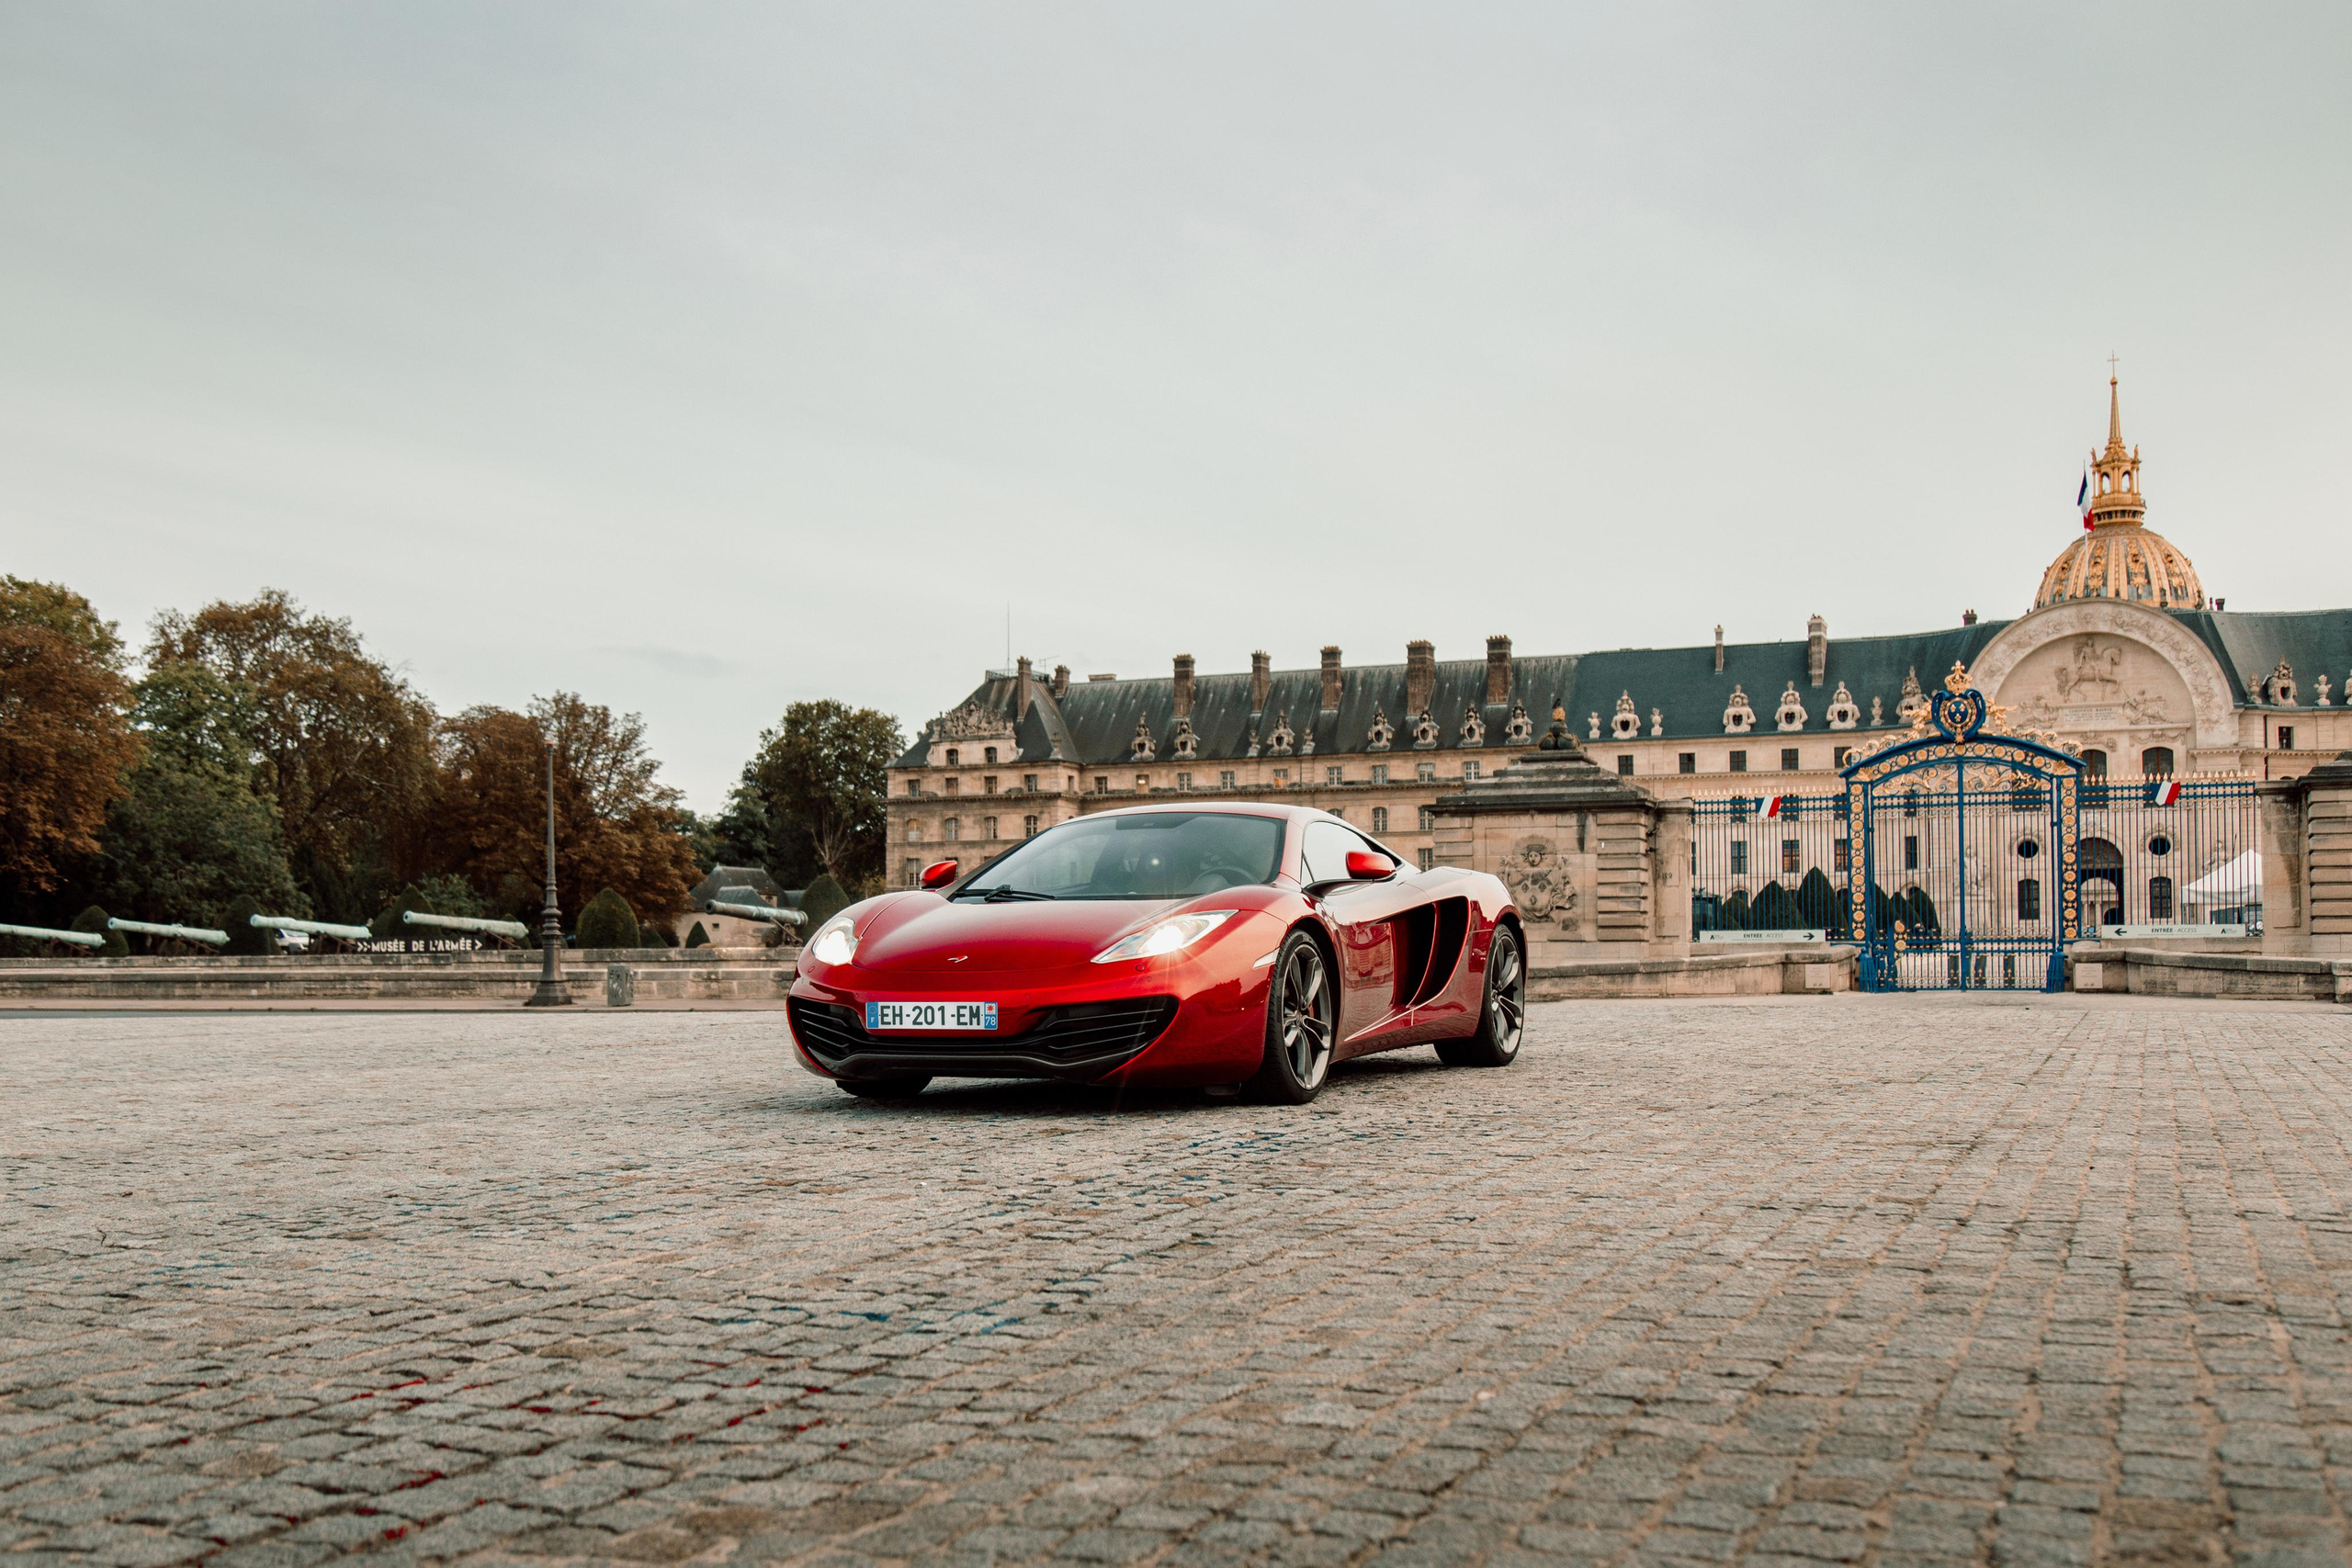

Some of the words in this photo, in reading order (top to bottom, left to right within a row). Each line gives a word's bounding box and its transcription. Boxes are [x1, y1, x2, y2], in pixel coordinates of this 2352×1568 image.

[371, 939, 405, 953] MUSÉE
[412, 940, 424, 952] DE
[430, 937, 472, 952] L'ARMÉE
[880, 1005, 980, 1026] EH-201-EM
[985, 1016, 996, 1026] 78
